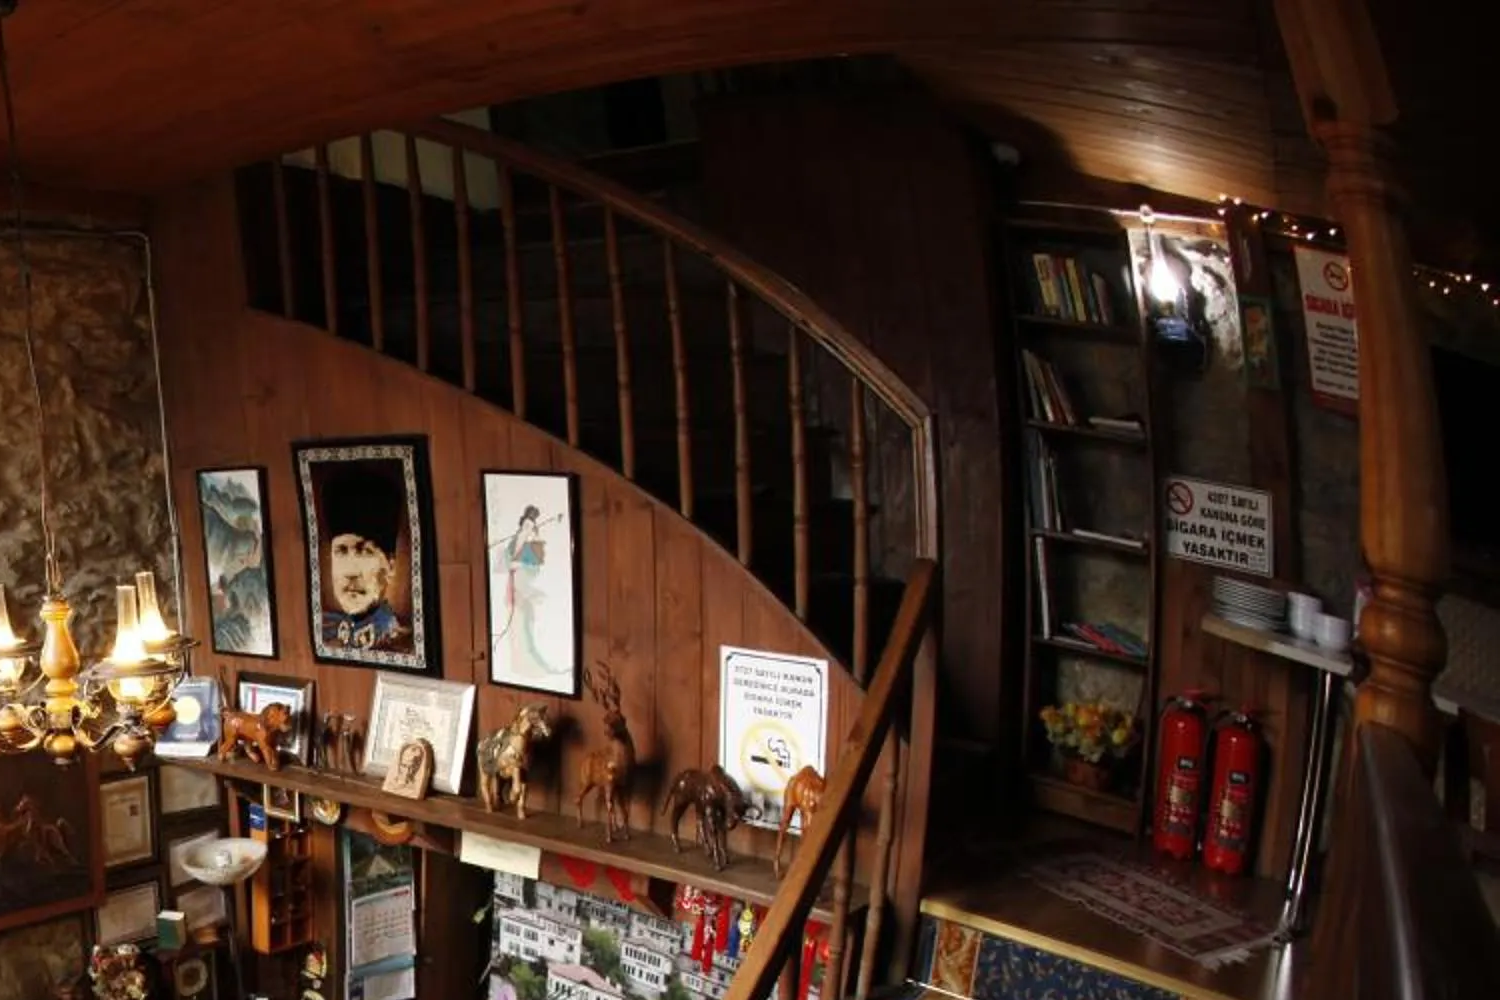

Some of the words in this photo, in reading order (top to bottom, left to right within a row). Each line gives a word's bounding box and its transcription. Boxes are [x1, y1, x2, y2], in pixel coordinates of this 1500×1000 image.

[1200, 507, 1238, 523] KANUNA
[1221, 526, 1265, 549] İÇMEK
[1182, 541, 1249, 565] YASAKTIR
